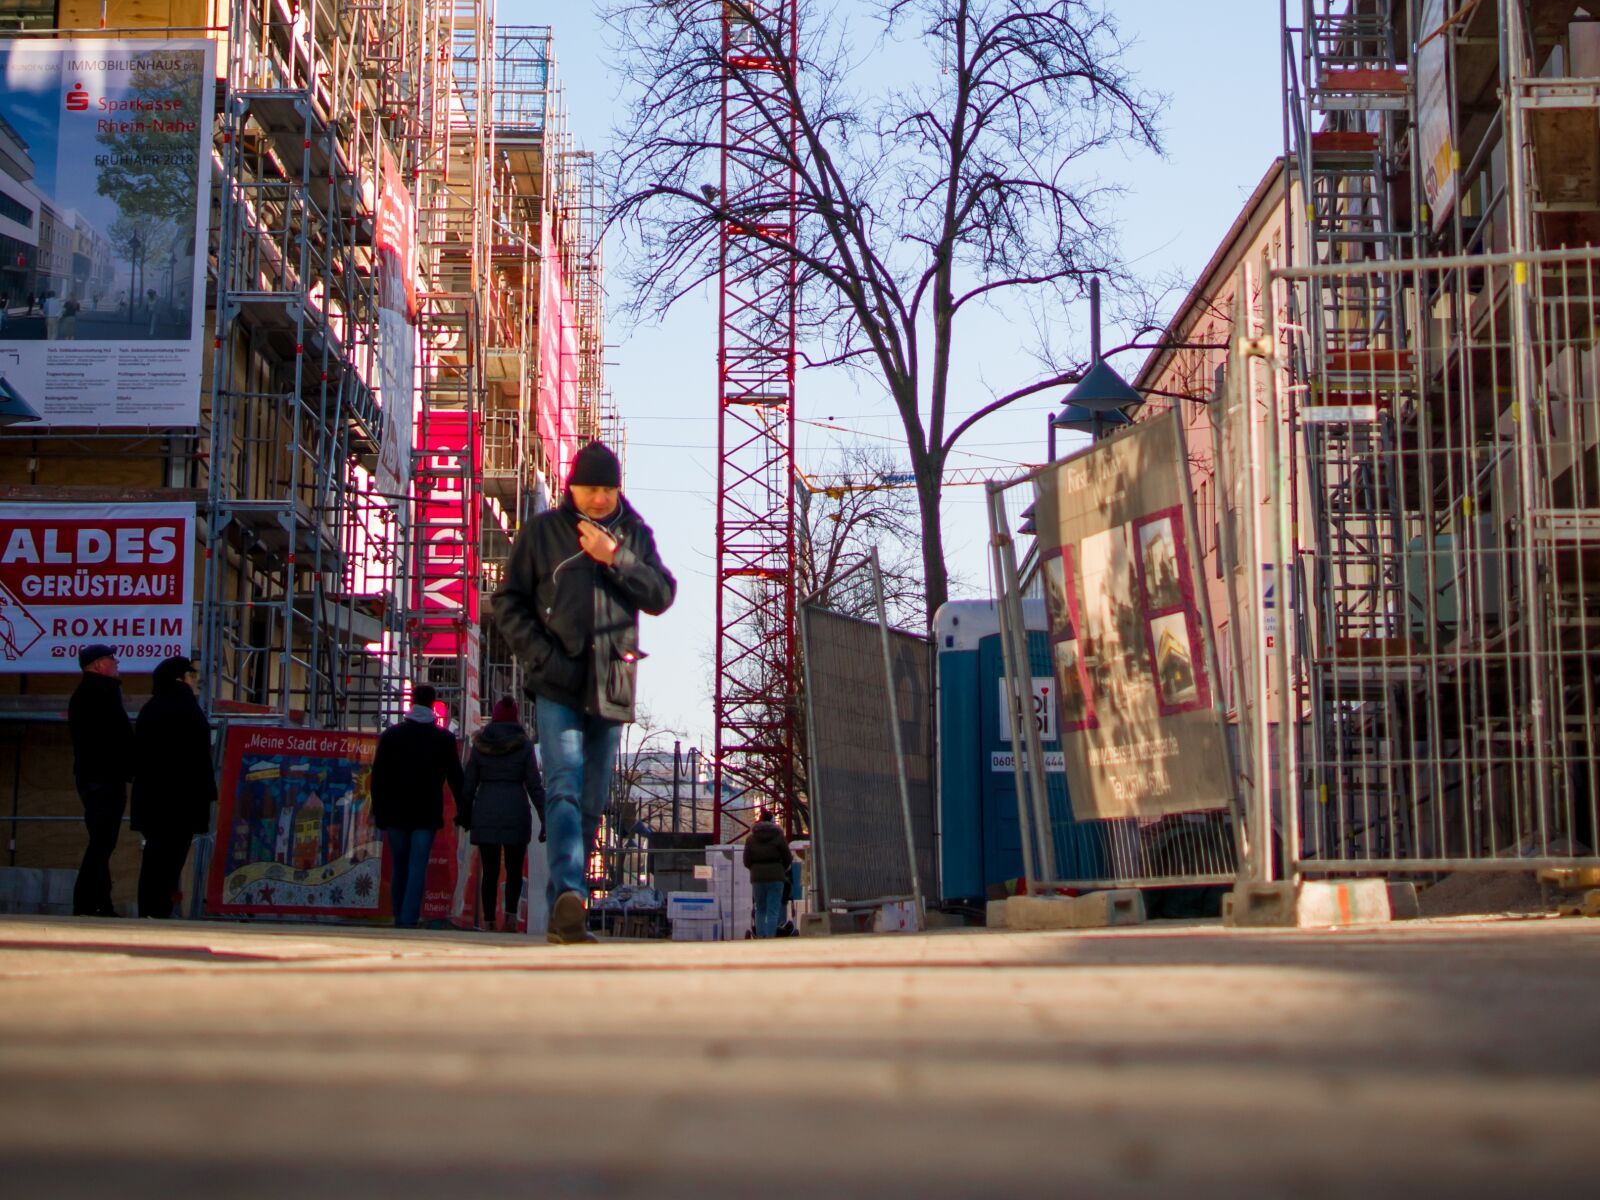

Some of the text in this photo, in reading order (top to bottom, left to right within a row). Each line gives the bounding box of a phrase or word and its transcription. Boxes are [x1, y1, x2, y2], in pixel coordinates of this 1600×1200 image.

[68, 60, 181, 71] IMMOBILIENHAUS
[98, 96, 183, 113] Sparkasse
[97, 119, 197, 133] Rhein-Nahe
[163, 154, 193, 166] 2018
[1, 527, 177, 564] ALDES
[21, 569, 167, 597] GERÜSTBAU
[52, 618, 183, 637] ROXHEIM
[136, 644, 162, 658] 892
[163, 644, 182, 658] 08
[286, 735, 316, 751] Stadt
[320, 737, 338, 753] der
